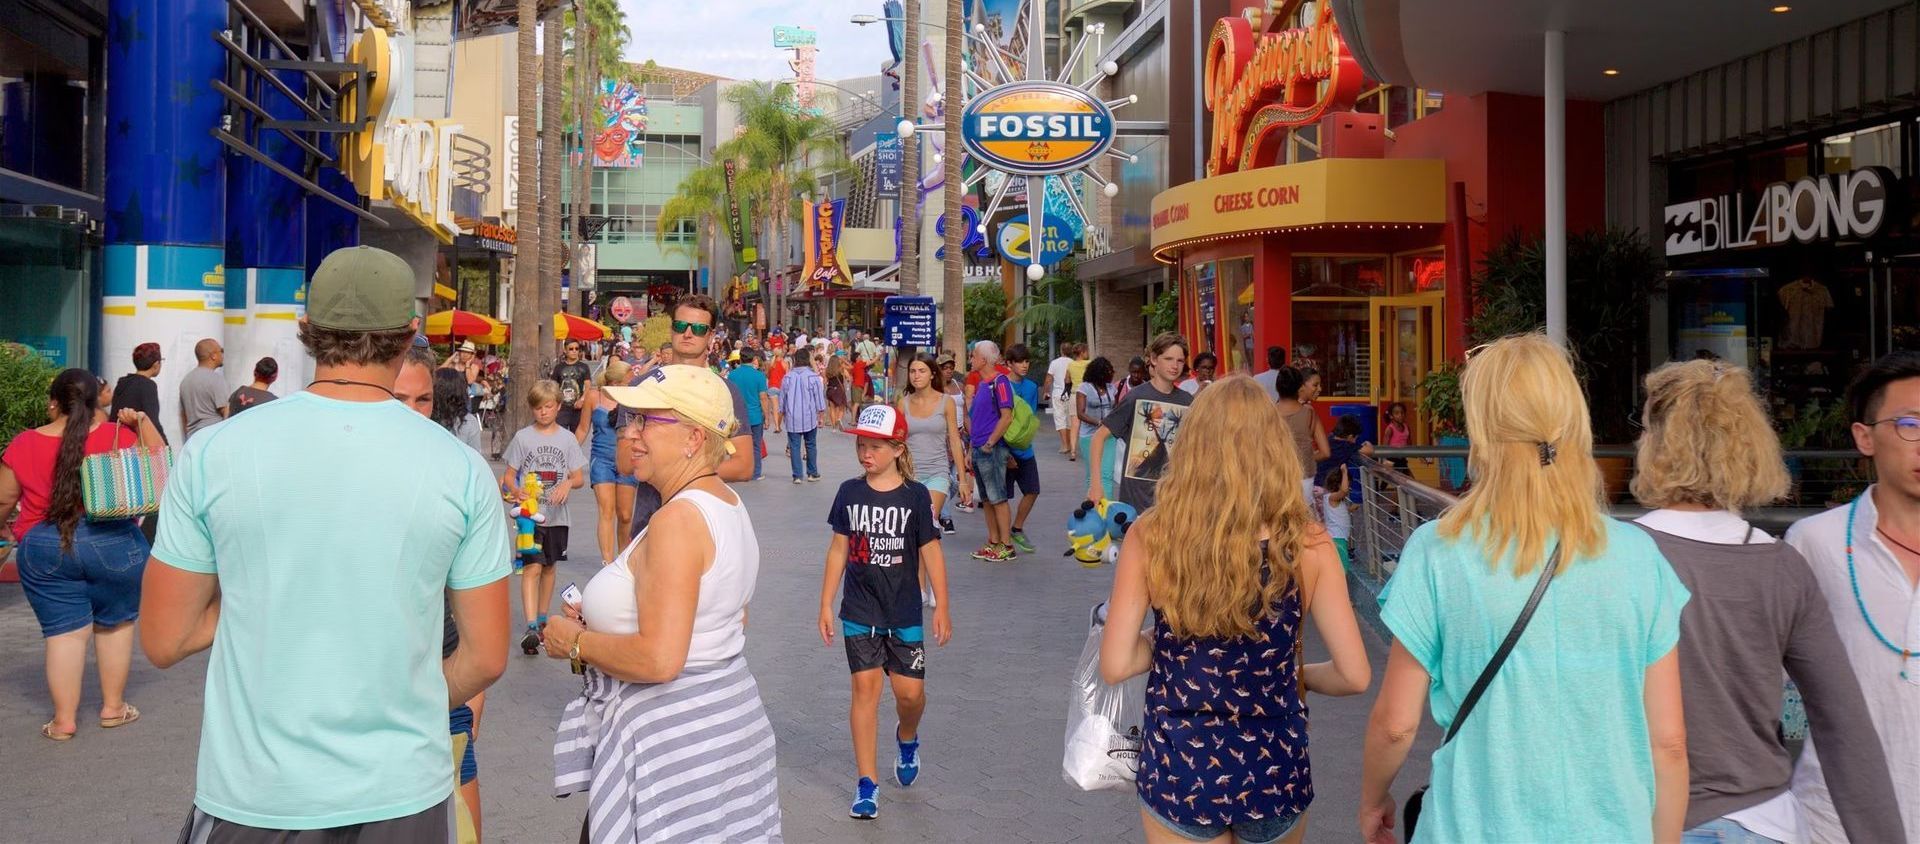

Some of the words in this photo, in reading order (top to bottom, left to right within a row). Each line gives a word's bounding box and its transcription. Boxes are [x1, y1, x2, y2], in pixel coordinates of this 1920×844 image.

[980, 115, 1100, 137] FOSSIL
[1214, 191, 1254, 214] CHEESE
[1257, 184, 1300, 208] CORN
[1701, 168, 1886, 251] BILLABONG
[732, 217, 741, 245] PUCK
[818, 203, 833, 267] CREPE
[846, 504, 912, 537] MARQY
[869, 537, 905, 550] FASHION
[1116, 752, 1139, 760] HOLLY
